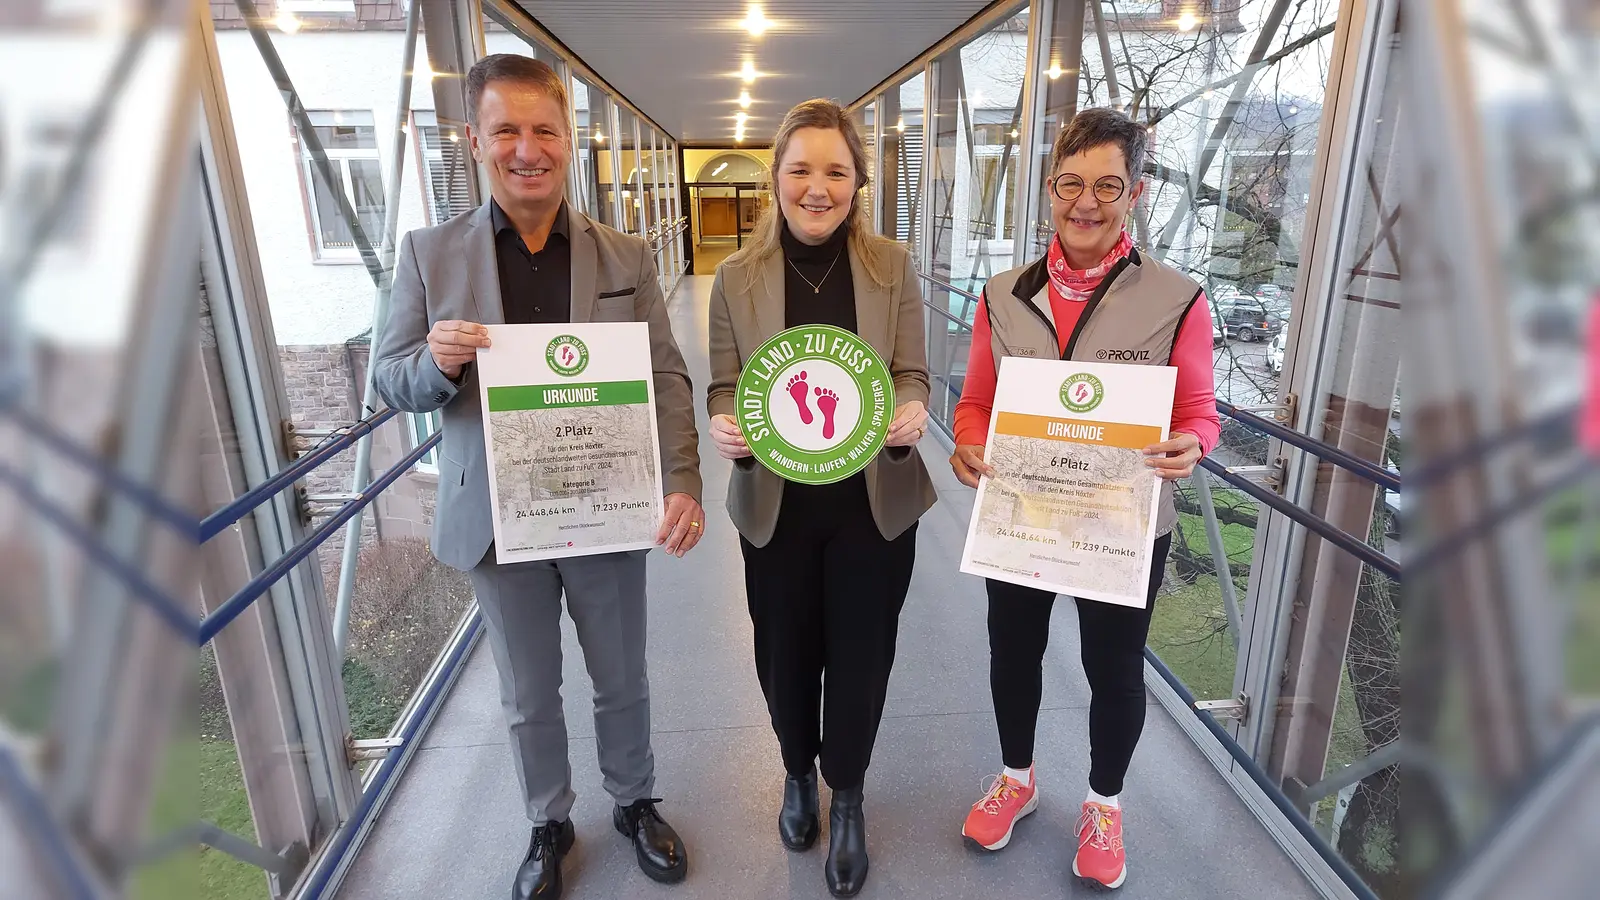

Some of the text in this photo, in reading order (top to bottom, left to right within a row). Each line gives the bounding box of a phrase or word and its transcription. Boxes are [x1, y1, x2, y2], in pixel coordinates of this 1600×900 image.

[1108, 349, 1150, 361] PROVIZ
[743, 333, 873, 442] STADT LAND ZU FUSS
[543, 387, 599, 405] URKUNDE
[555, 425, 594, 437] 2.Platz
[769, 378, 885, 474] WANDERN LAUFEN WALKEN SPAZIEREN
[1047, 421, 1105, 441] URKUNDE
[547, 442, 603, 453] für den Kreis Höxter
[512, 458, 521, 466] bei
[522, 457, 532, 465] der
[560, 464, 575, 473] Land
[1050, 456, 1089, 471] 6.Platz
[562, 478, 596, 489] Kategorie B
[1011, 471, 1020, 479] der
[1021, 472, 1077, 486] deutschlandweiten
[1000, 489, 1010, 497] bei
[1037, 484, 1096, 499] für den Kreis Höxter
[516, 500, 650, 519] 24.448,64 km 17.239 Punkte
[996, 527, 1136, 558] 24.448,64 km 17.239 Punkte
